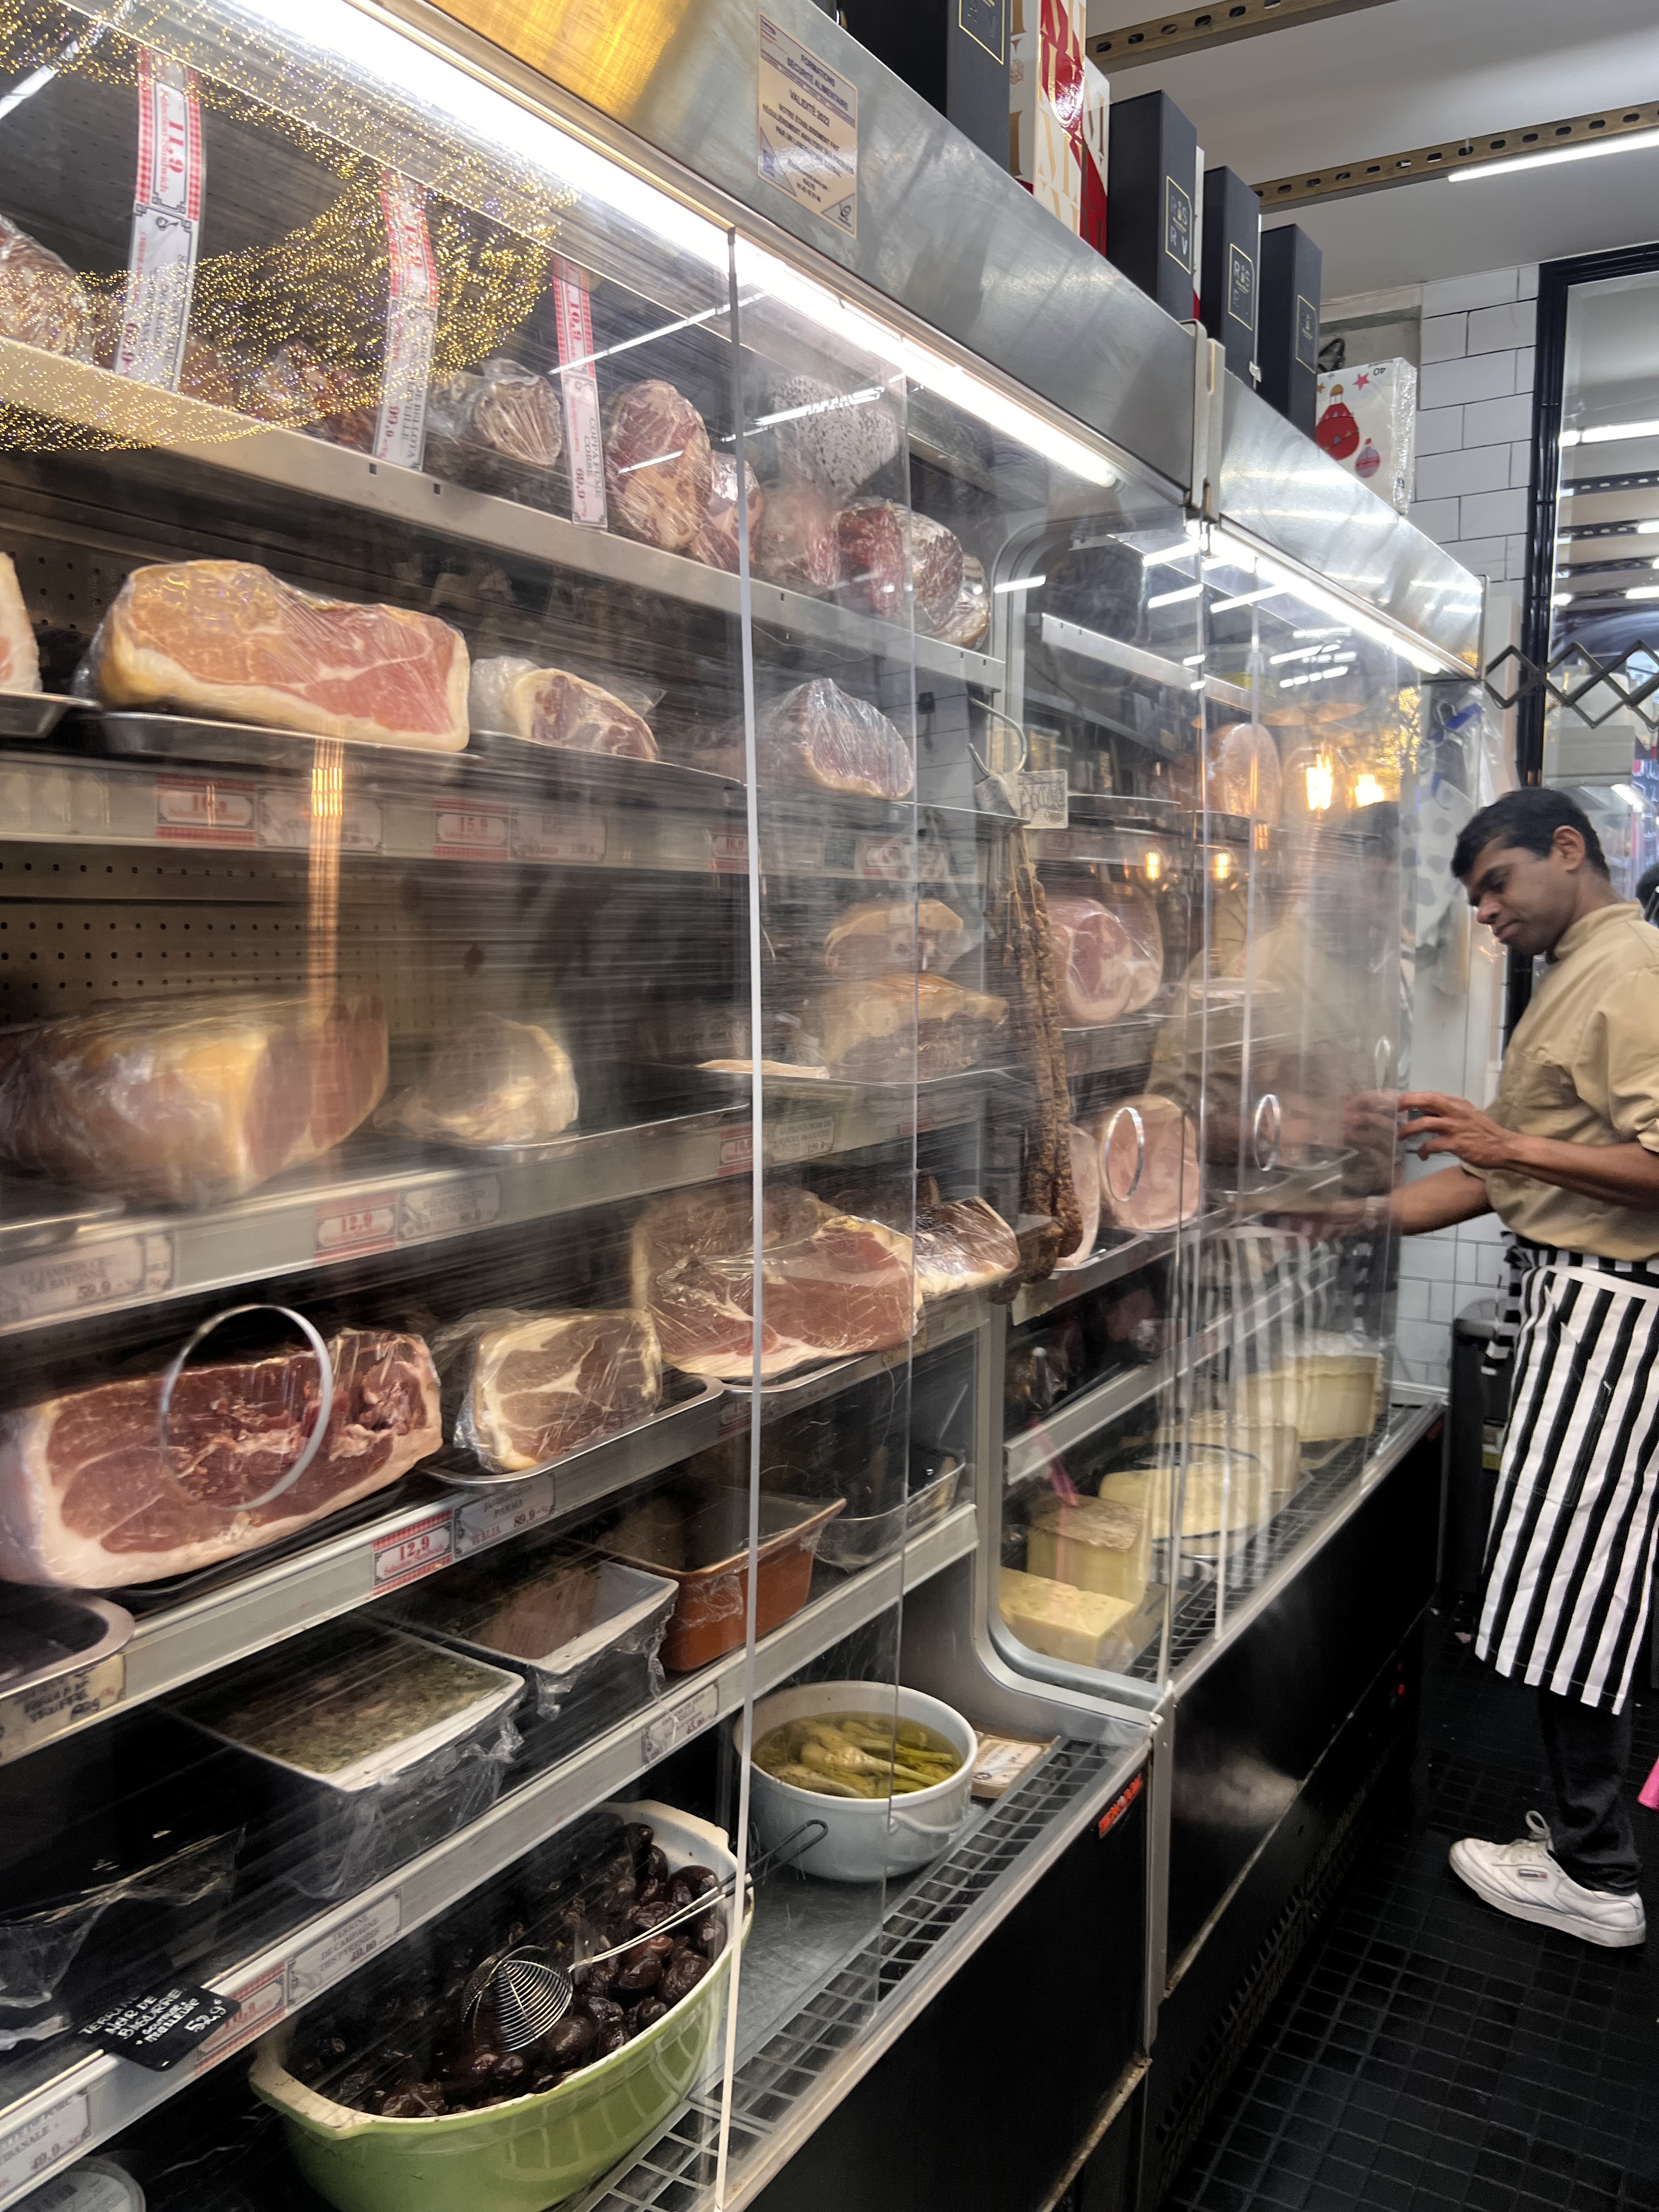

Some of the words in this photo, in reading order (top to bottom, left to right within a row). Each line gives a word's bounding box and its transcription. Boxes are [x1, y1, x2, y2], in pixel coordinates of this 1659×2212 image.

[408, 404, 422, 459] BELLOTA
[589, 417, 600, 460] COPPA
[584, 435, 594, 478] CORSE
[494, 1498, 523, 1519] PARMA
[472, 1525, 501, 1545] ITALIA
[399, 1536, 430, 1561] 12,9
[136, 1995, 157, 2010] DE
